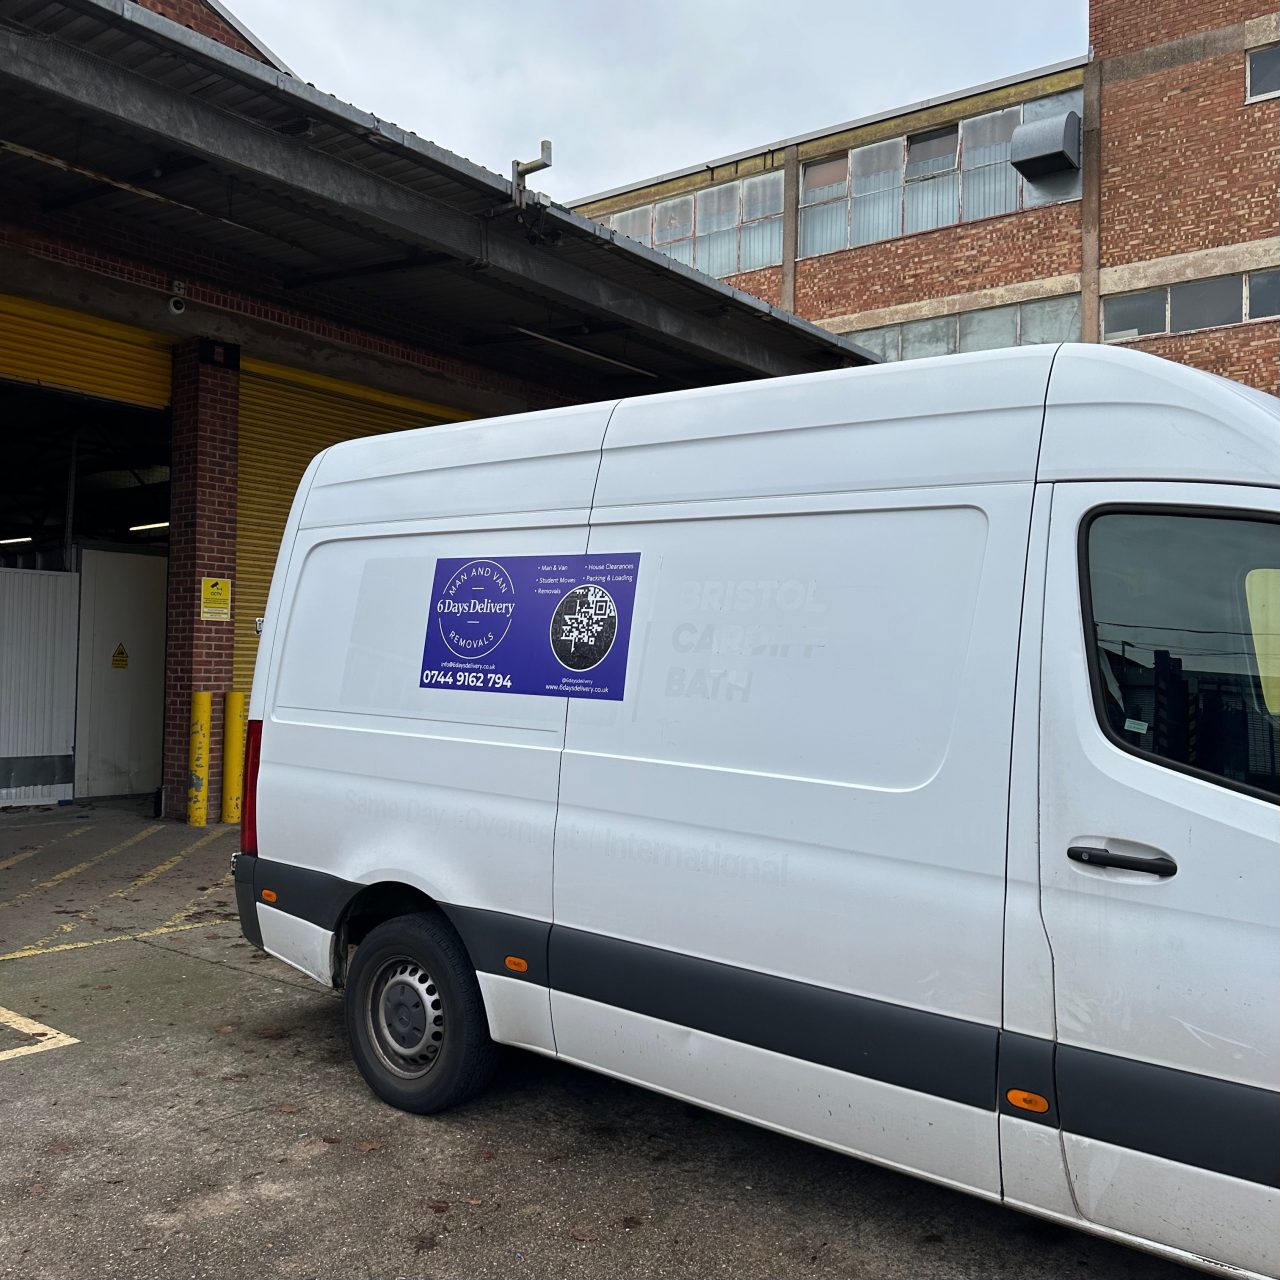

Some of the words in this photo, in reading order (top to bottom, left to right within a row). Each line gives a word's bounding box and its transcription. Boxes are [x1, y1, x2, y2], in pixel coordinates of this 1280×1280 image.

[450, 572, 468, 596] MAN
[470, 567, 490, 577] AND
[492, 572, 508, 593] VAN
[437, 599, 444, 613] 6
[444, 599, 470, 617] Days
[470, 598, 515, 618] Delivery
[449, 630, 494, 649] REMOVALS
[422, 670, 454, 685] 0744
[456, 672, 484, 687] 9162
[487, 674, 513, 688] 794
[546, 683, 609, 693] www.6daysdelivery.co.uk
